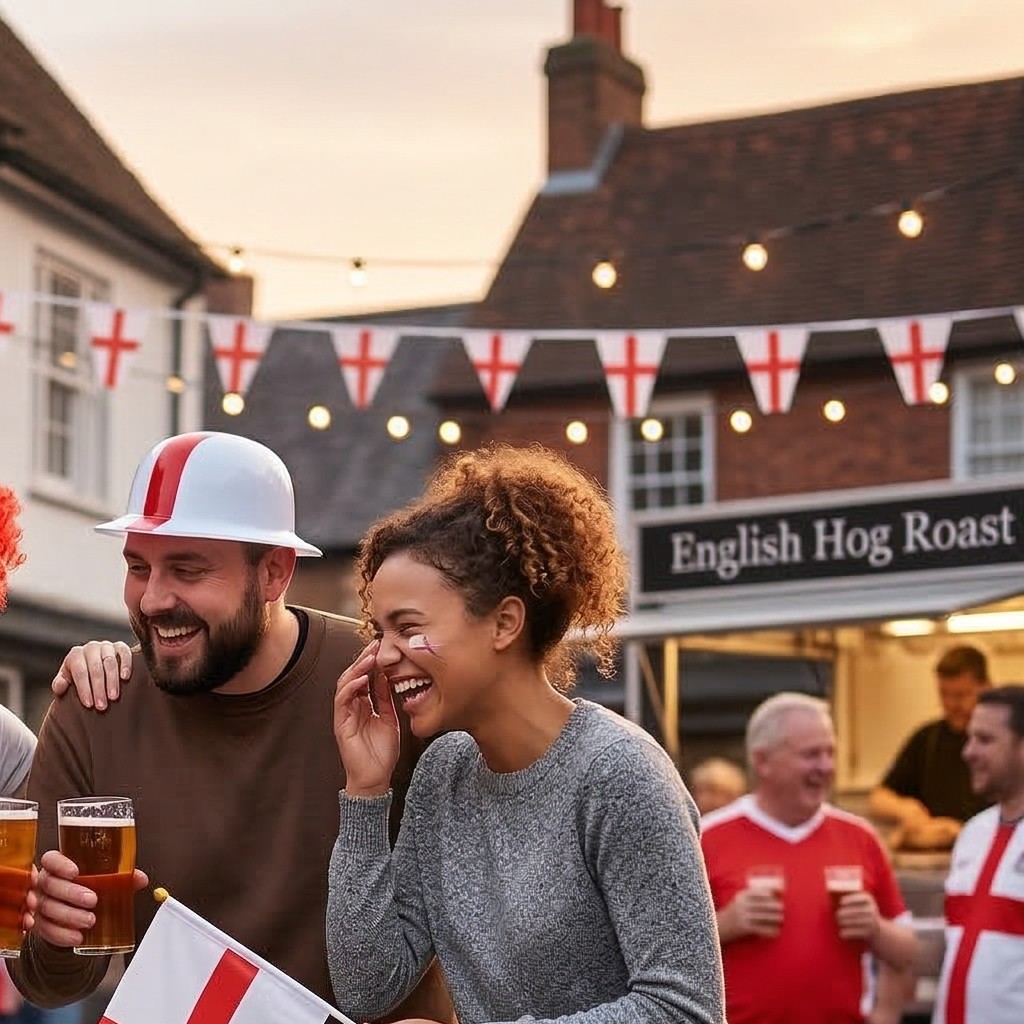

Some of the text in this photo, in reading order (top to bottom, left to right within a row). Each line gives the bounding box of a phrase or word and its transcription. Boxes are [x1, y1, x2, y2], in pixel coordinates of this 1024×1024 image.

[671, 506, 1016, 580] English Hog Roast
